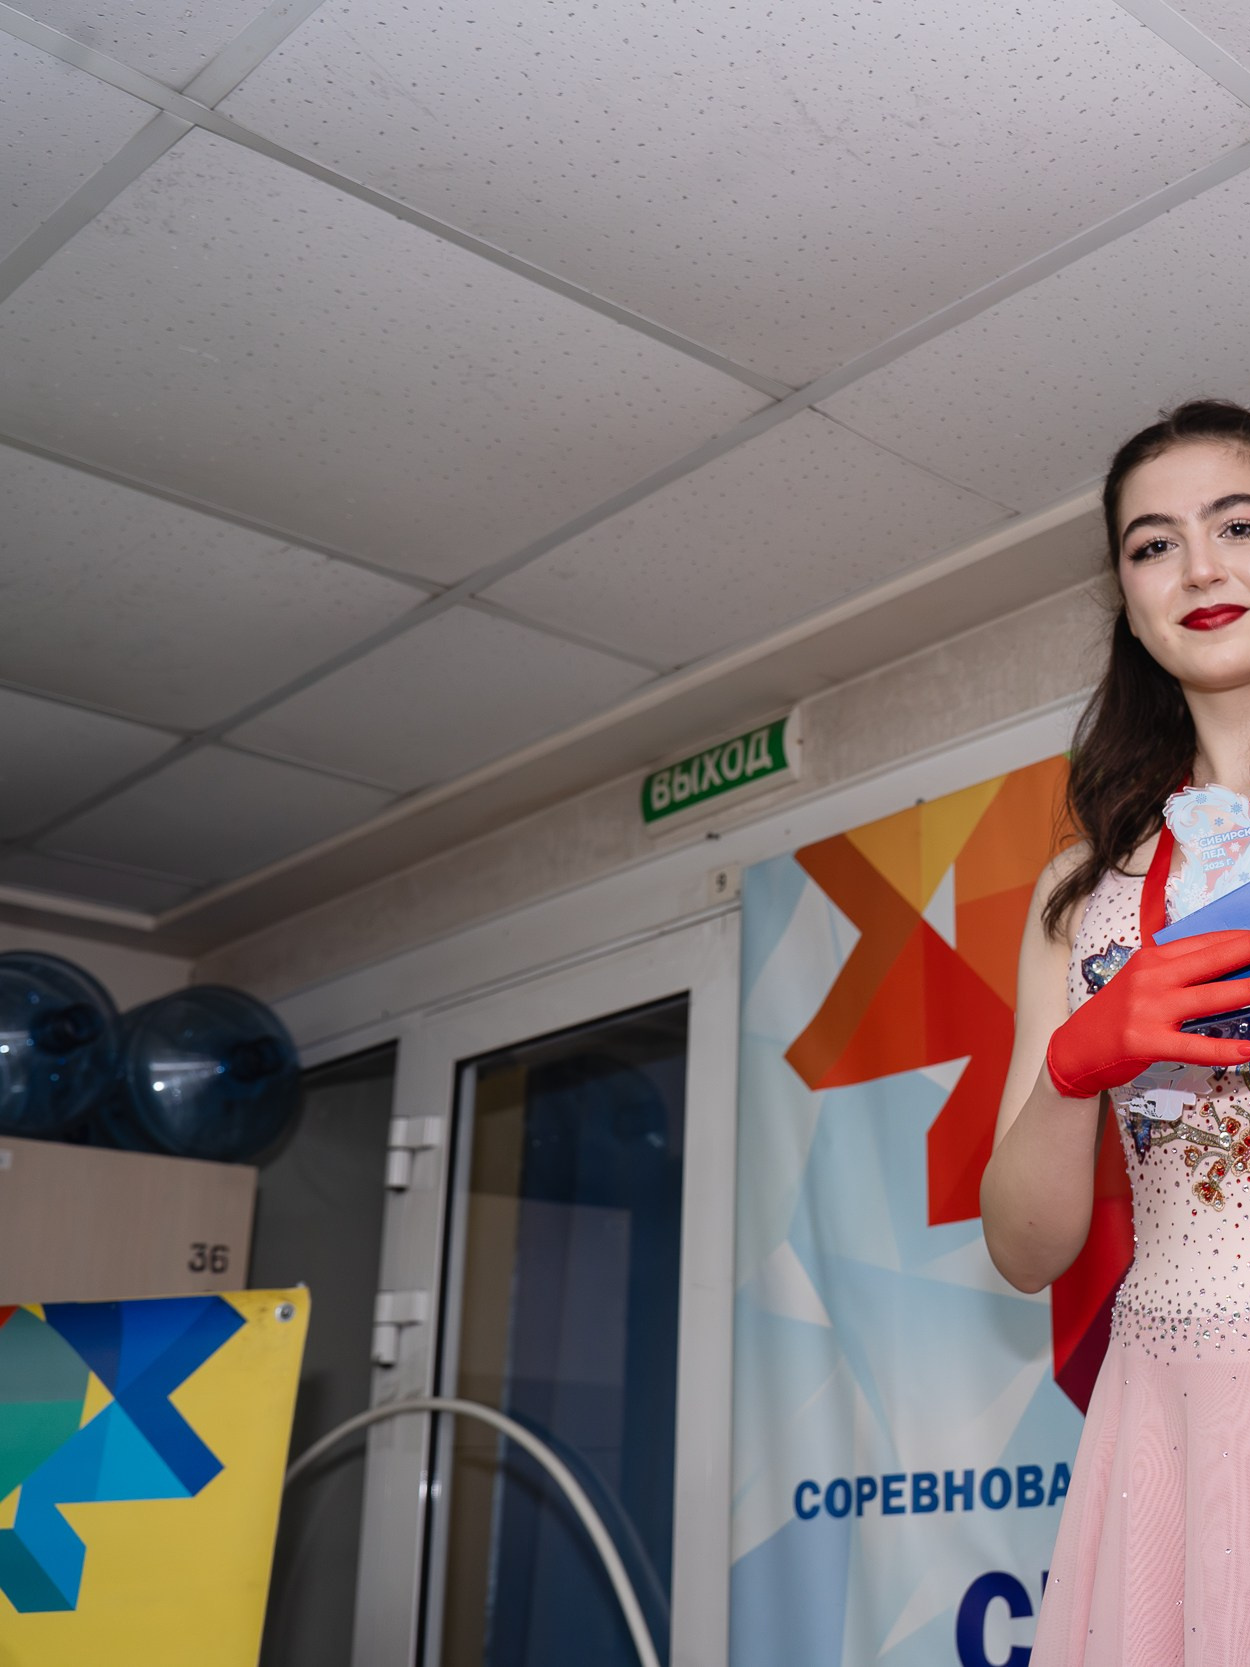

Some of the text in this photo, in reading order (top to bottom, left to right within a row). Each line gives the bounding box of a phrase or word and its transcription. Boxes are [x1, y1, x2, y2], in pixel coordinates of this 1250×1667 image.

[651, 729, 773, 812] ВЫХОД
[187, 1242, 230, 1274] 36
[793, 1462, 1071, 1521] СОРЕВНОВА
[956, 1570, 1050, 1667] С
